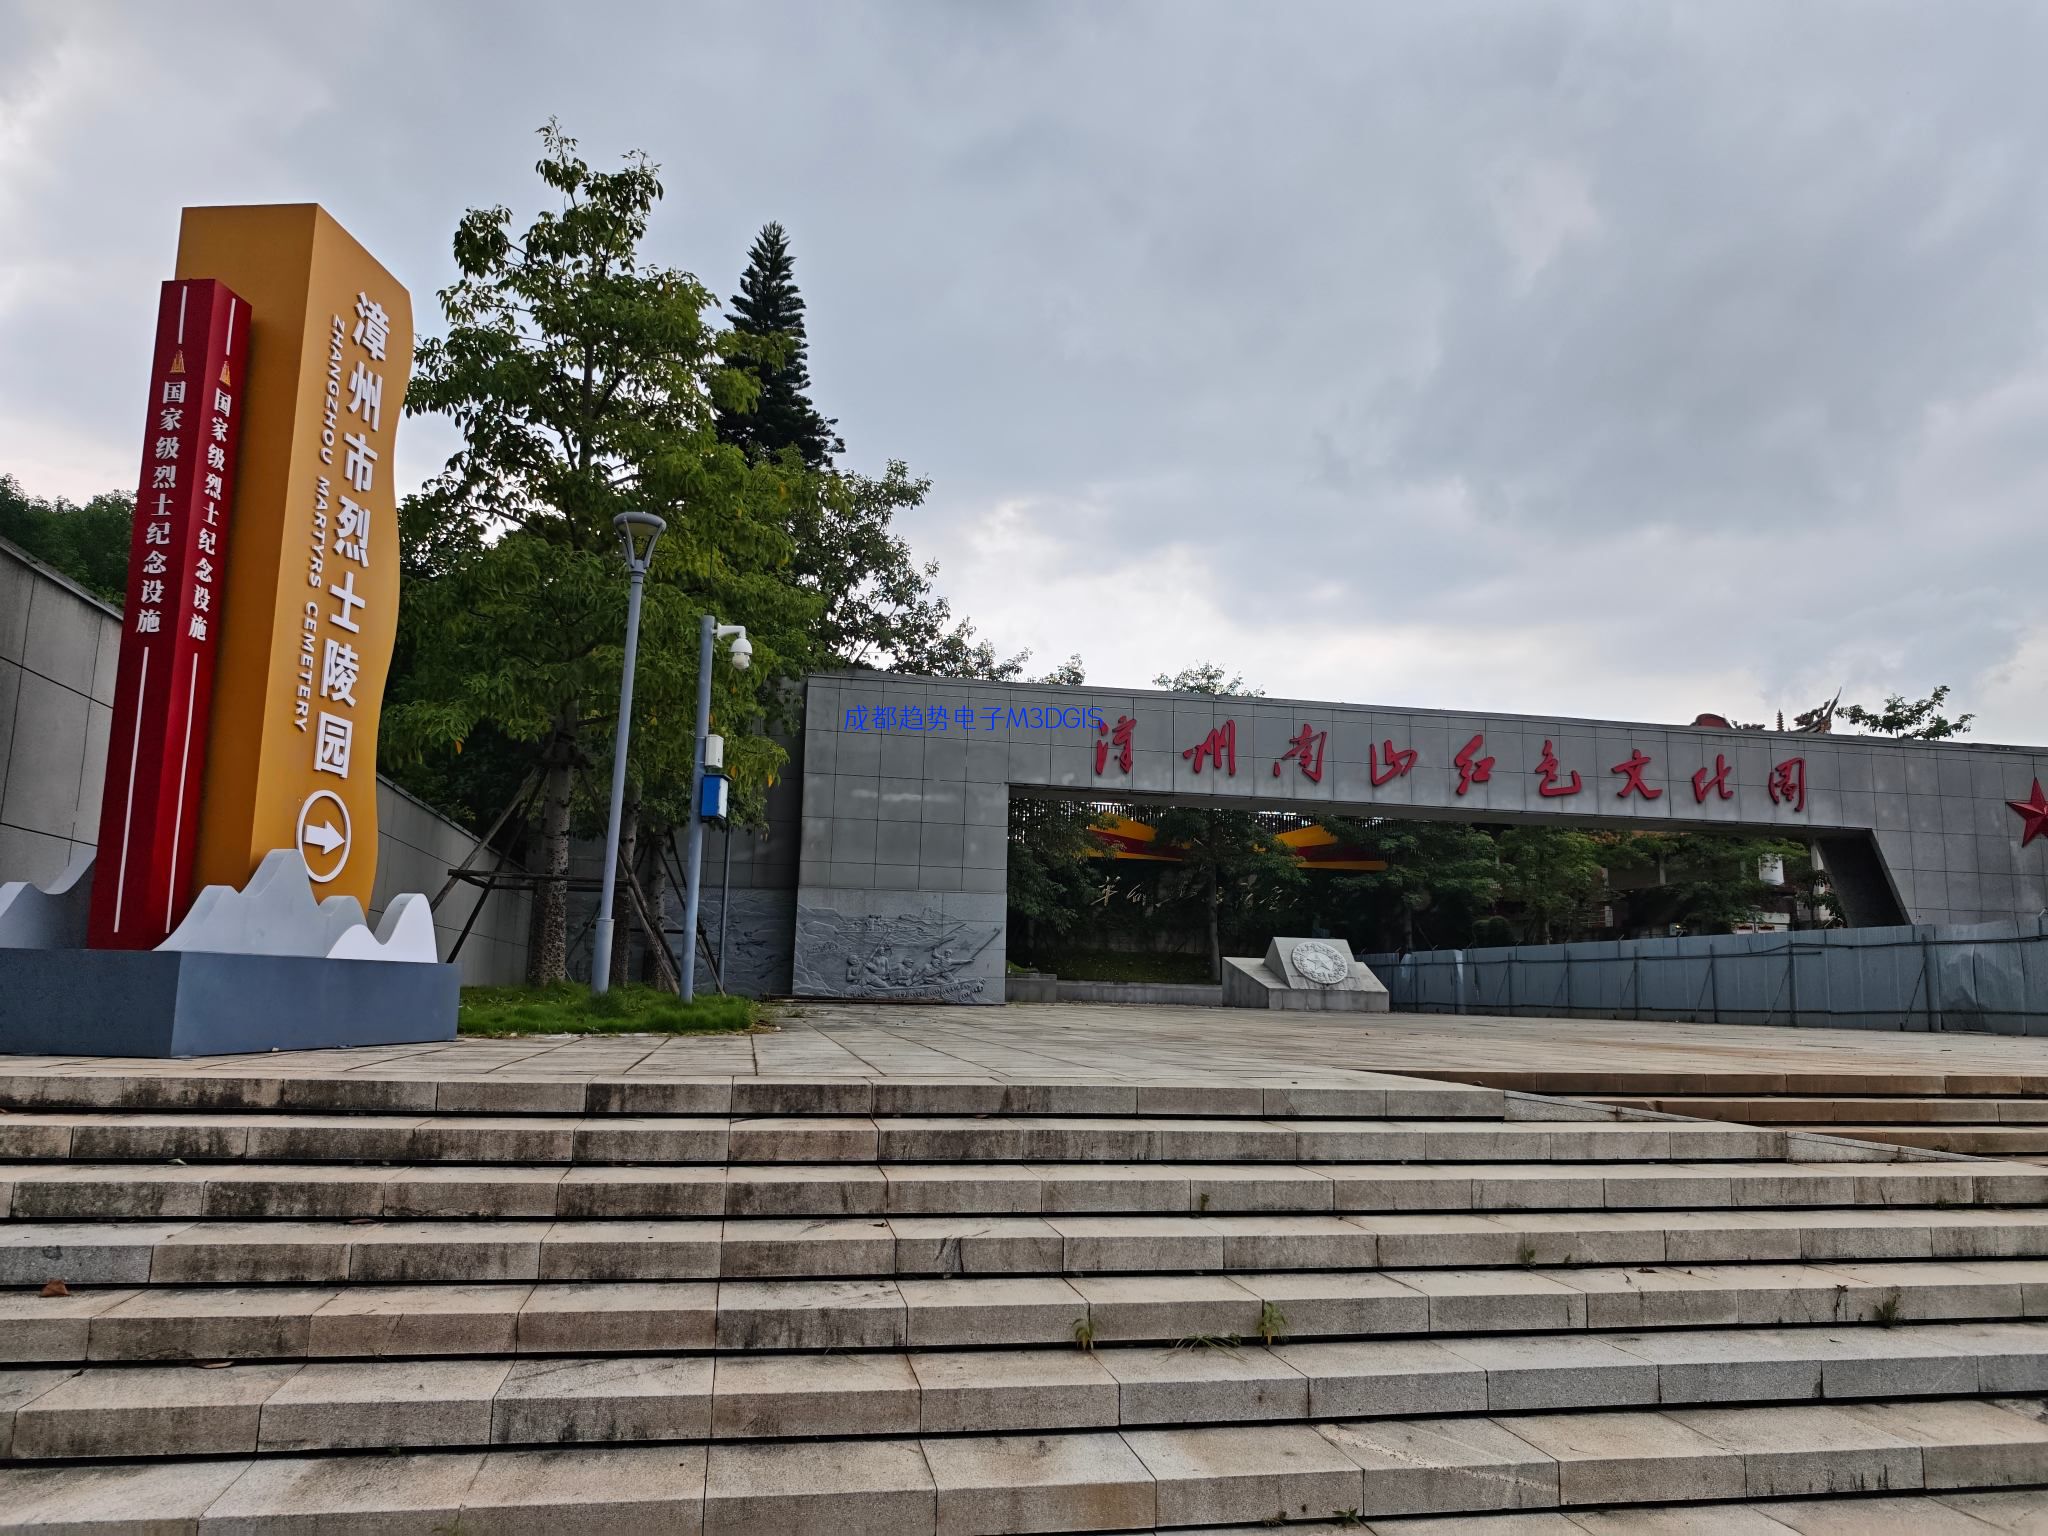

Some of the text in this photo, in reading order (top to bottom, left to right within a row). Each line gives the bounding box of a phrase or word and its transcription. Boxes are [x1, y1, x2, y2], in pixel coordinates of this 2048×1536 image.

[136, 380, 187, 633] 国家级烈士纪念设施
[188, 386, 232, 642] 国家级烈士纪念设施
[294, 314, 346, 732] ZHANGZHOU MARTYRS CEMETERY
[313, 291, 391, 779] 漳州市烈士陵园
